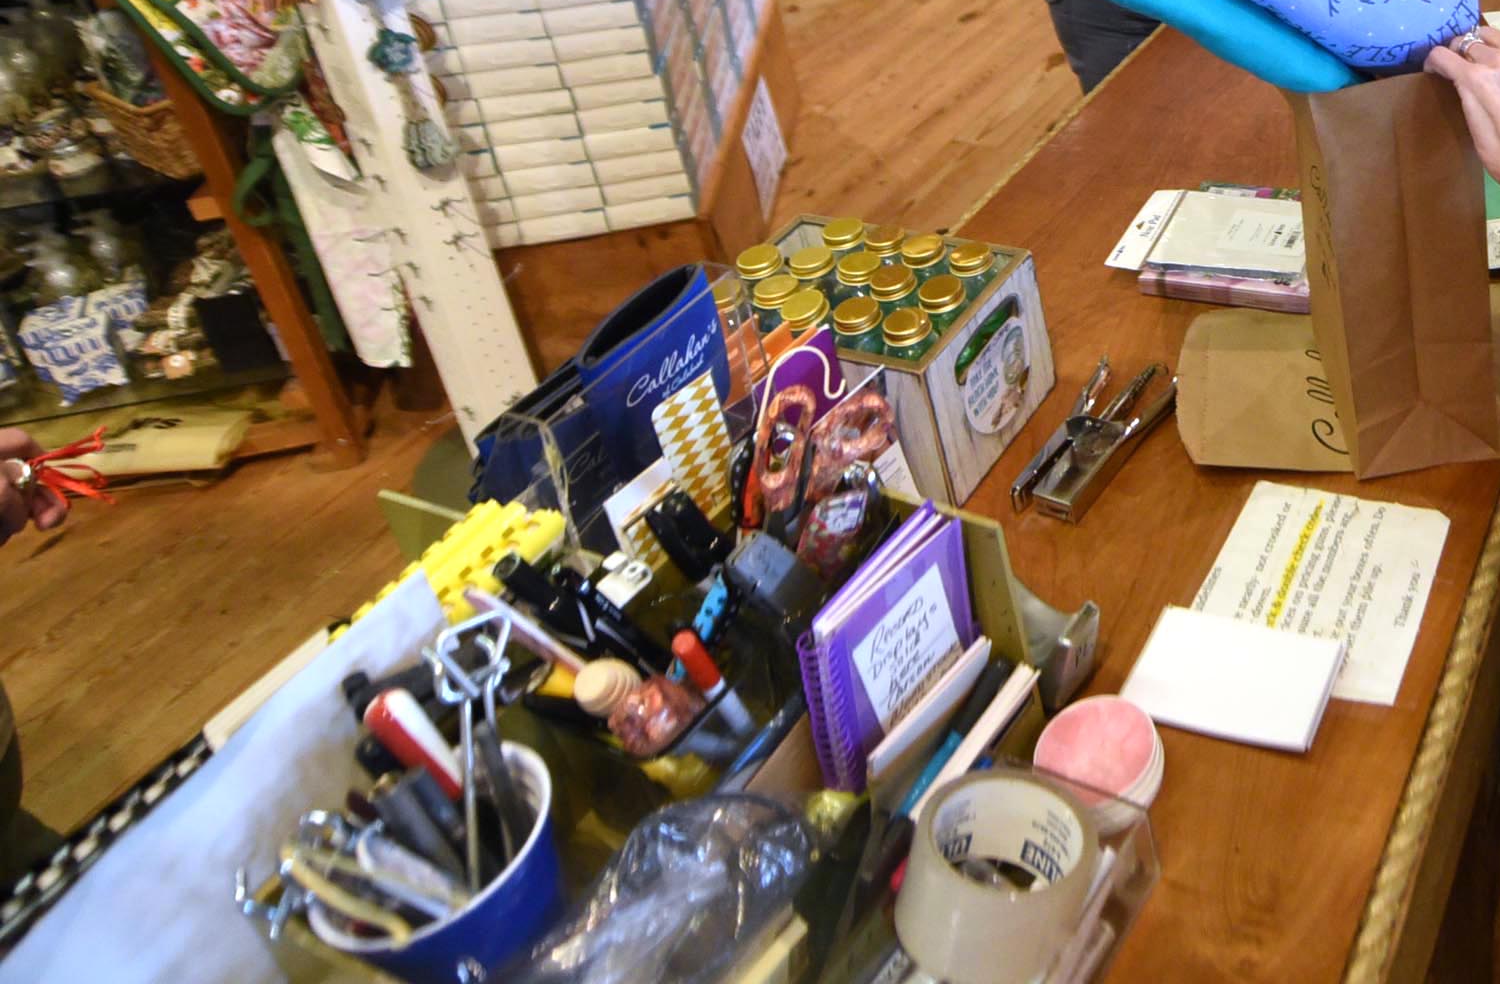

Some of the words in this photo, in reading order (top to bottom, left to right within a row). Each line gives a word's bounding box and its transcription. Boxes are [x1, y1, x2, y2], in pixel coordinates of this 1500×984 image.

[626, 318, 718, 408] Callahan's
[1393, 594, 1414, 629] Thank
[1407, 571, 1422, 596] you
